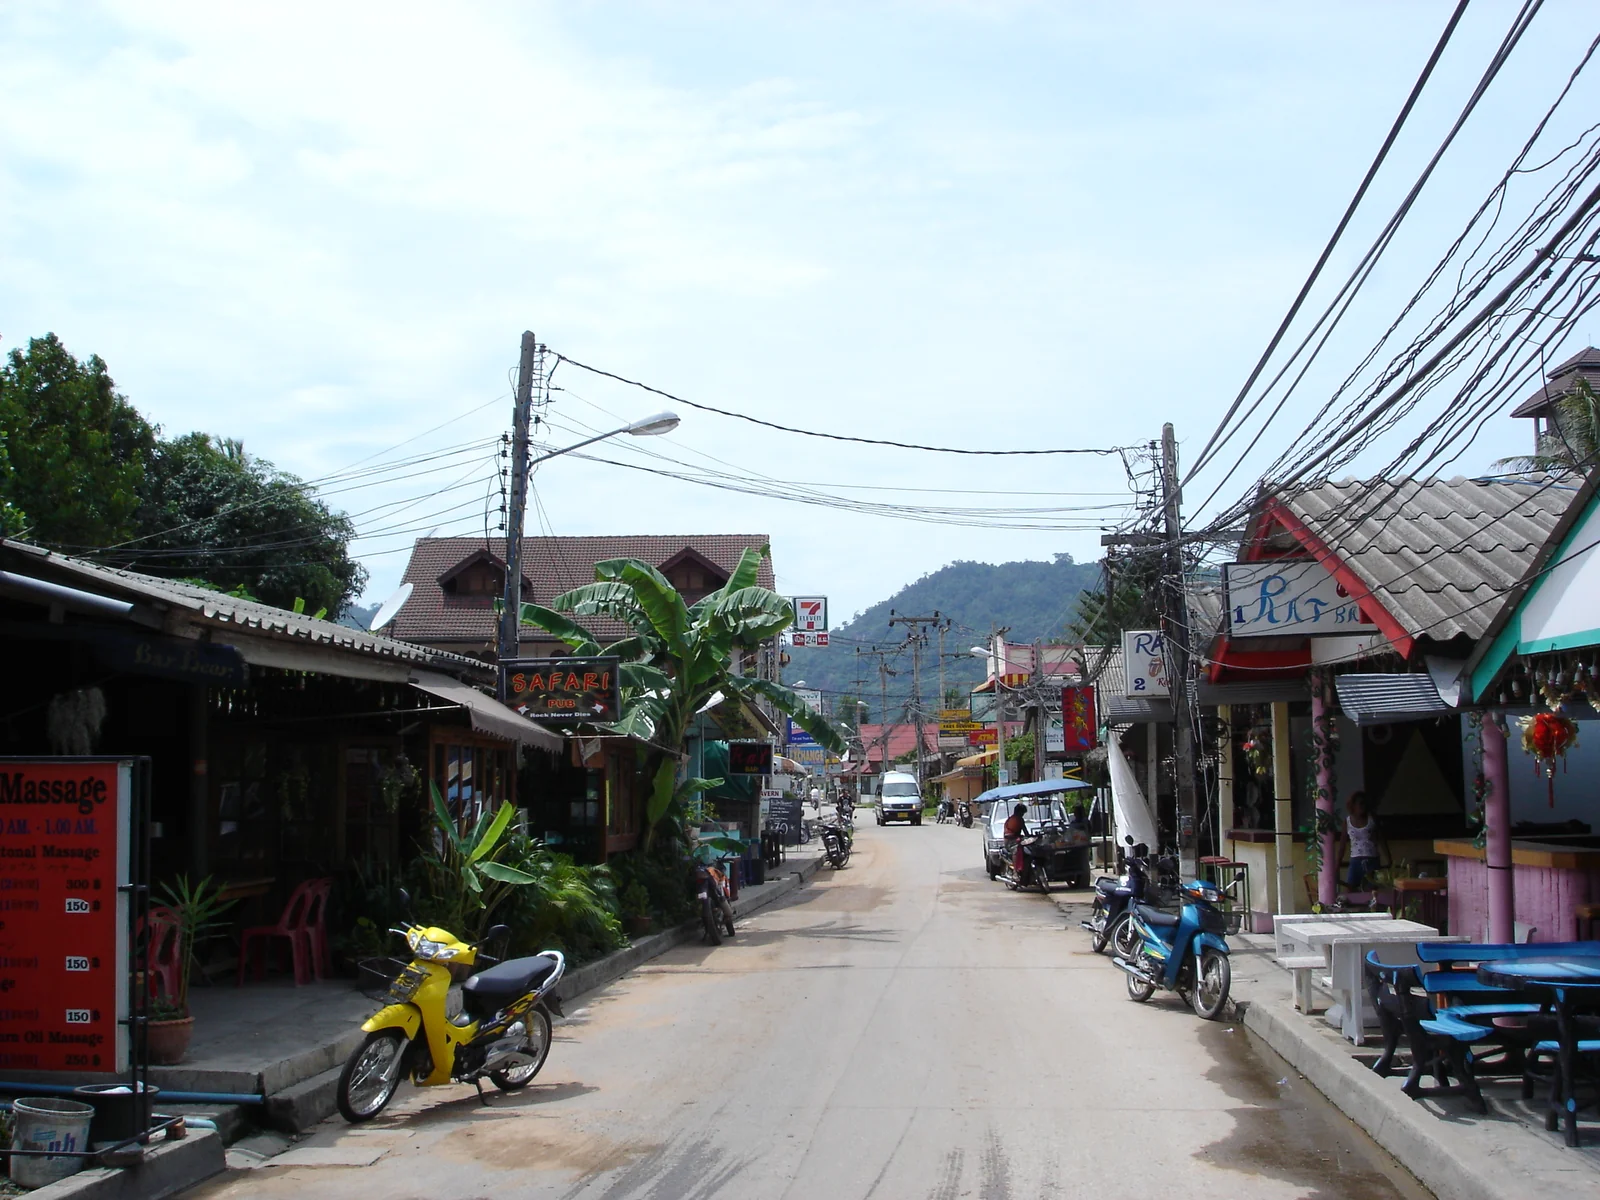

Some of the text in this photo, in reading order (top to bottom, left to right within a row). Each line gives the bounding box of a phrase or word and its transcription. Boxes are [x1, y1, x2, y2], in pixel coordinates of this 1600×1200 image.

[1233, 575, 1360, 624] 1 RAT BA
[805, 635, 817, 645] 24
[1133, 632, 1165, 657] RA
[512, 672, 609, 693] SAFARI
[1134, 677, 1146, 691] 2
[548, 699, 576, 709] PUB
[0, 773, 107, 814] Massage
[42, 846, 100, 862] Massage
[66, 901, 88, 912] 150
[66, 959, 88, 969] 150
[67, 1011, 89, 1022] 150
[24, 1030, 43, 1043] Oil
[48, 1031, 104, 1047] Massage
